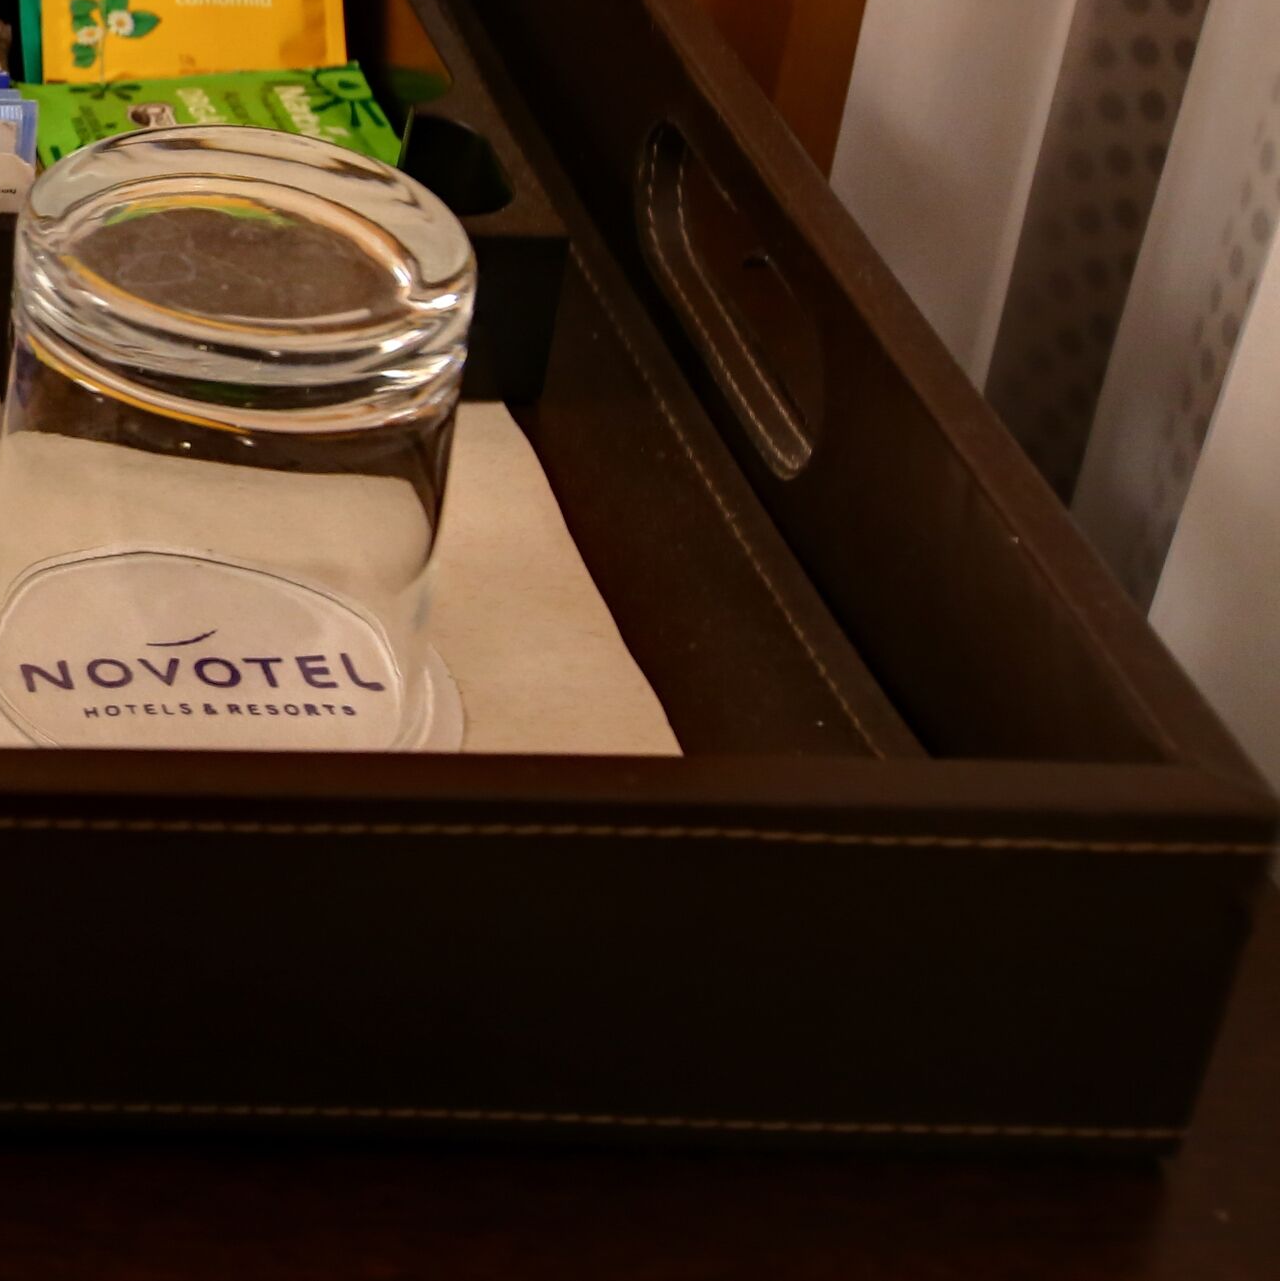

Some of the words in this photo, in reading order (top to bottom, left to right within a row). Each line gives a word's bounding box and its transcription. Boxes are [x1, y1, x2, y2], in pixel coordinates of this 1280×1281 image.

[19, 652, 386, 693] NOVOTEL
[83, 703, 194, 718] HOTELS
[226, 703, 358, 717] RESORTS
